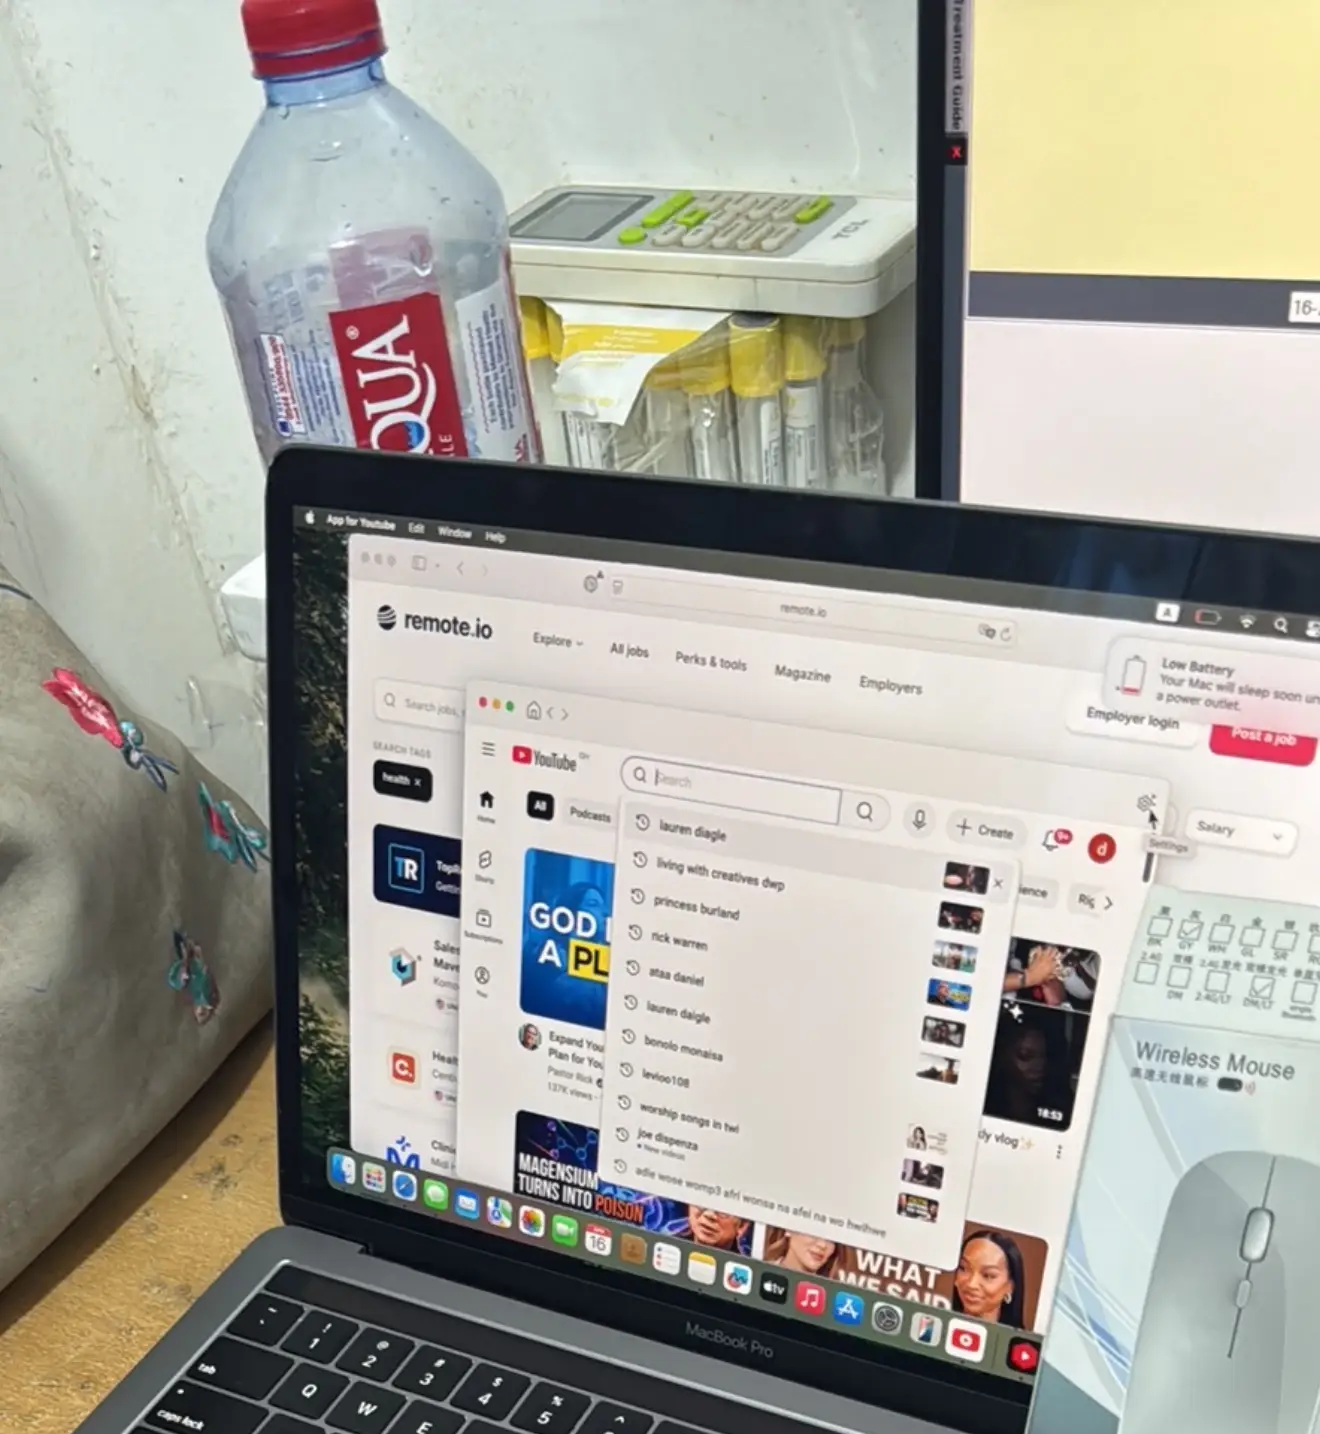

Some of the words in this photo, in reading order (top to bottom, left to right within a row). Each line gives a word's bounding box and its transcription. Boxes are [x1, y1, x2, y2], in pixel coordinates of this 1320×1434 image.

[951, 85, 963, 131] Guide
[830, 216, 869, 242] TCL
[1294, 299, 1320, 316] 16-
[326, 514, 344, 527] App
[346, 517, 358, 527] for
[360, 518, 396, 531] Youtube
[408, 522, 425, 534] Edit
[438, 526, 473, 539] Window
[485, 531, 507, 544] Help
[780, 602, 827, 618] remote.io
[404, 613, 493, 640] remote.io
[533, 631, 572, 649] Explore
[610, 642, 624, 656] All
[625, 645, 649, 660] jobs
[675, 650, 706, 667] Perks
[709, 656, 718, 668] &
[720, 657, 747, 673] tools
[775, 664, 831, 684] Magazine
[1162, 658, 1186, 670] Low
[1189, 661, 1234, 678] Battery
[859, 675, 923, 696] Employers
[1160, 674, 1185, 687] Your
[1188, 677, 1213, 691] Mac
[1216, 681, 1235, 693] will
[1238, 684, 1270, 699] sleep
[1273, 690, 1302, 702] soon
[1166, 693, 1200, 708] power
[1204, 698, 1241, 711] outlet.
[1087, 707, 1145, 726] Employer
[1148, 715, 1180, 730] login
[534, 750, 577, 772] YouTube
[382, 772, 410, 786] health
[534, 800, 547, 812] All
[570, 806, 612, 824] Podcasts
[659, 819, 692, 836] lauren
[694, 825, 727, 843] diagle
[978, 823, 1014, 841] Create
[1196, 820, 1235, 838] Salary
[1097, 842, 1107, 856] d
[394, 856, 417, 880] TR
[657, 857, 684, 875] living
[687, 863, 709, 878] with
[711, 868, 759, 887] creatives
[762, 877, 785, 892] dwp
[653, 895, 698, 913] princess
[700, 907, 740, 921] burland
[529, 902, 597, 938] GOD
[651, 931, 670, 945] rick
[673, 936, 708, 951] warren
[538, 940, 562, 968] A
[673, 972, 705, 988] daniel
[647, 1001, 678, 1017] lauren
[680, 1007, 711, 1025] daigle
[549, 1031, 584, 1048] Expand
[644, 1034, 678, 1052] bonolo
[680, 1043, 723, 1062] monaisa
[548, 1047, 569, 1061] Plan
[571, 1052, 585, 1064] for
[1136, 1041, 1220, 1070] Wireless
[1226, 1053, 1295, 1081] Mouse
[640, 1102, 678, 1121] worship
[681, 1111, 711, 1128] songs
[713, 1119, 722, 1130] in
[1037, 1107, 1063, 1121] 18:53
[637, 1128, 653, 1141] joe
[655, 1131, 698, 1151] dispenza
[995, 1132, 1019, 1149] vlog
[518, 1151, 598, 1191] MAGENSIUM
[518, 1174, 559, 1202] TURNS
[562, 1187, 593, 1210] INTO
[595, 1194, 644, 1224] POISON
[589, 1234, 606, 1252] 16
[856, 1249, 942, 1290] WHAT
[686, 1321, 747, 1350] MacBook
[750, 1340, 774, 1359] Pro
[198, 1363, 216, 1375] tab
[362, 1355, 377, 1368] 2
[302, 1384, 318, 1399] Q
[157, 1408, 180, 1424] caps
[181, 1414, 204, 1431] lock
[357, 1402, 378, 1416] W
